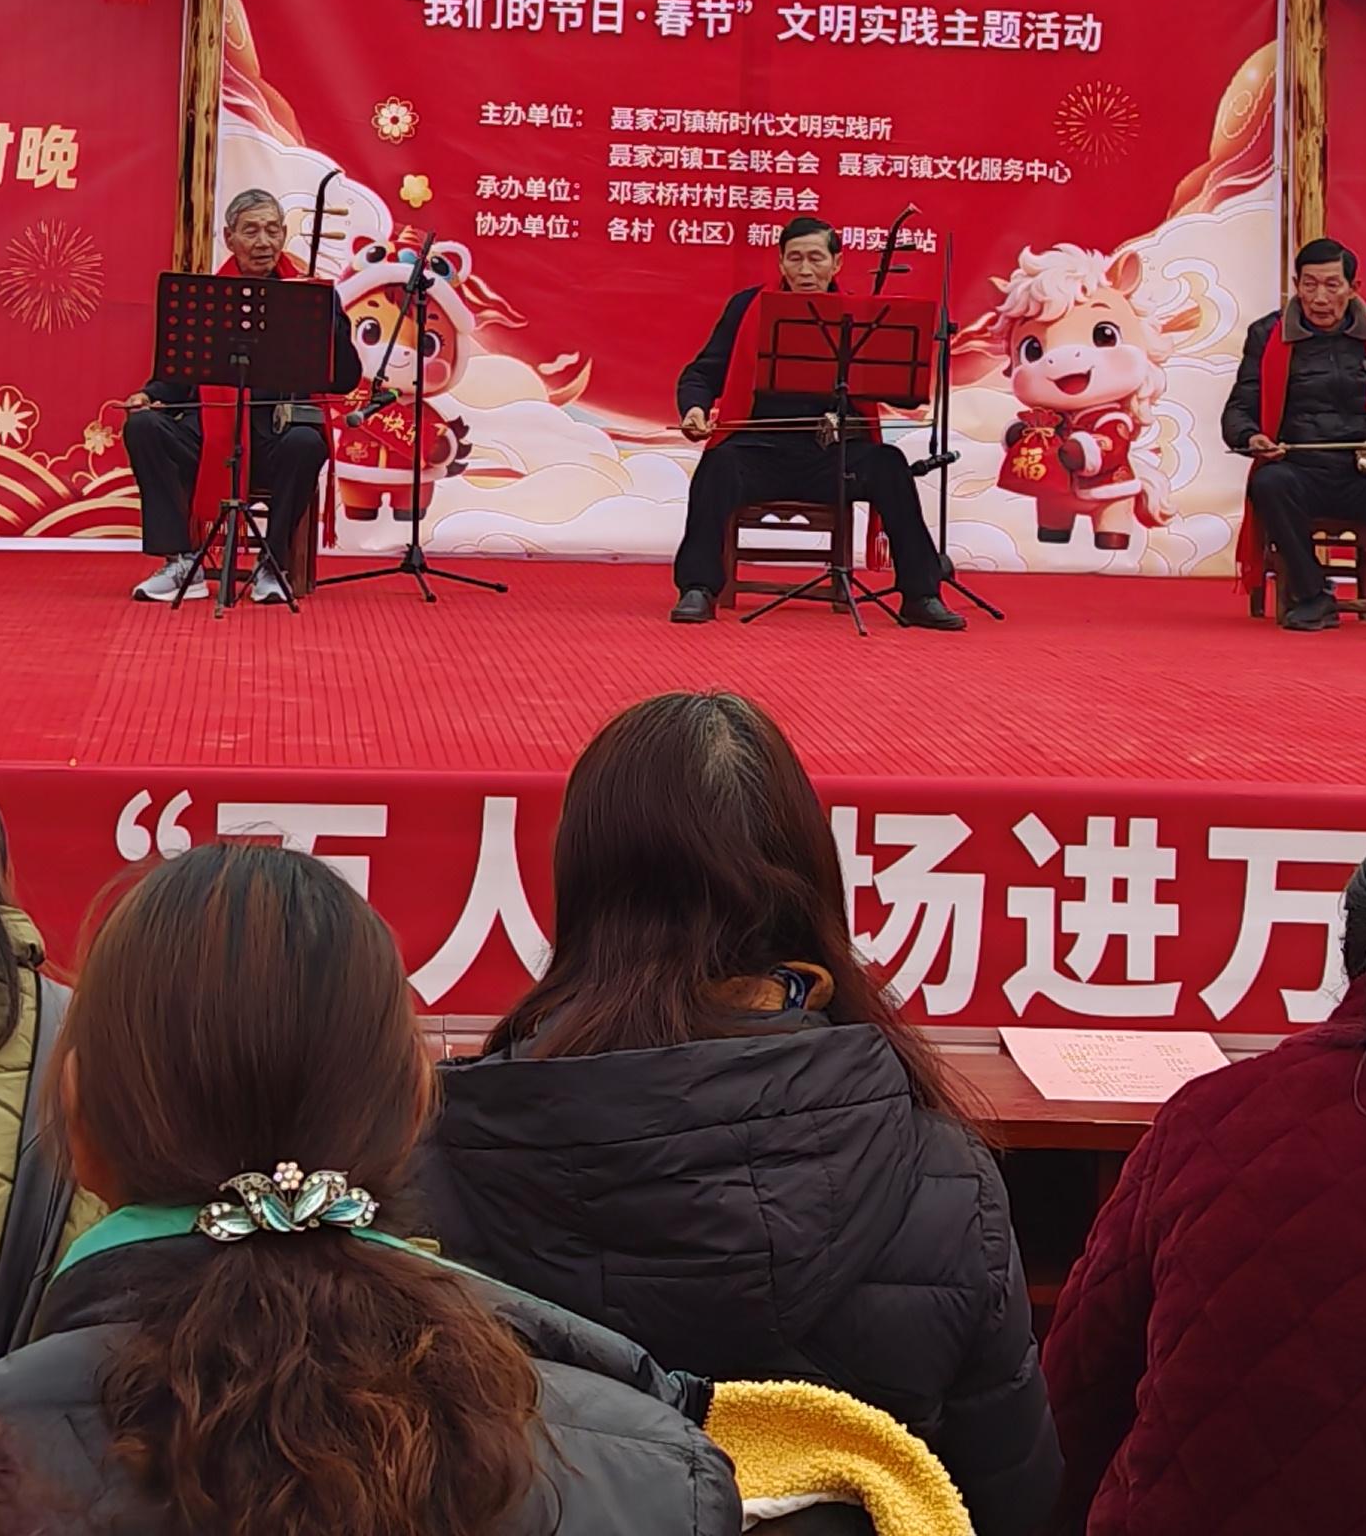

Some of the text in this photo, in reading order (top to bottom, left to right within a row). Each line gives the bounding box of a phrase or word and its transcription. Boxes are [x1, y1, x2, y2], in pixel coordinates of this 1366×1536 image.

[777, 2, 1104, 54] 文明实践主题活动
[479, 101, 893, 141] 主办单位： 聂家河镇新时代文明实践所
[608, 143, 1073, 184] 聂家河镇工会联合会 聂家河镇文化服务中心
[475, 175, 821, 213] 承办单位： 邓家桥村村民委员会
[475, 211, 581, 240] 协办单位：
[1012, 447, 1047, 482] 福
